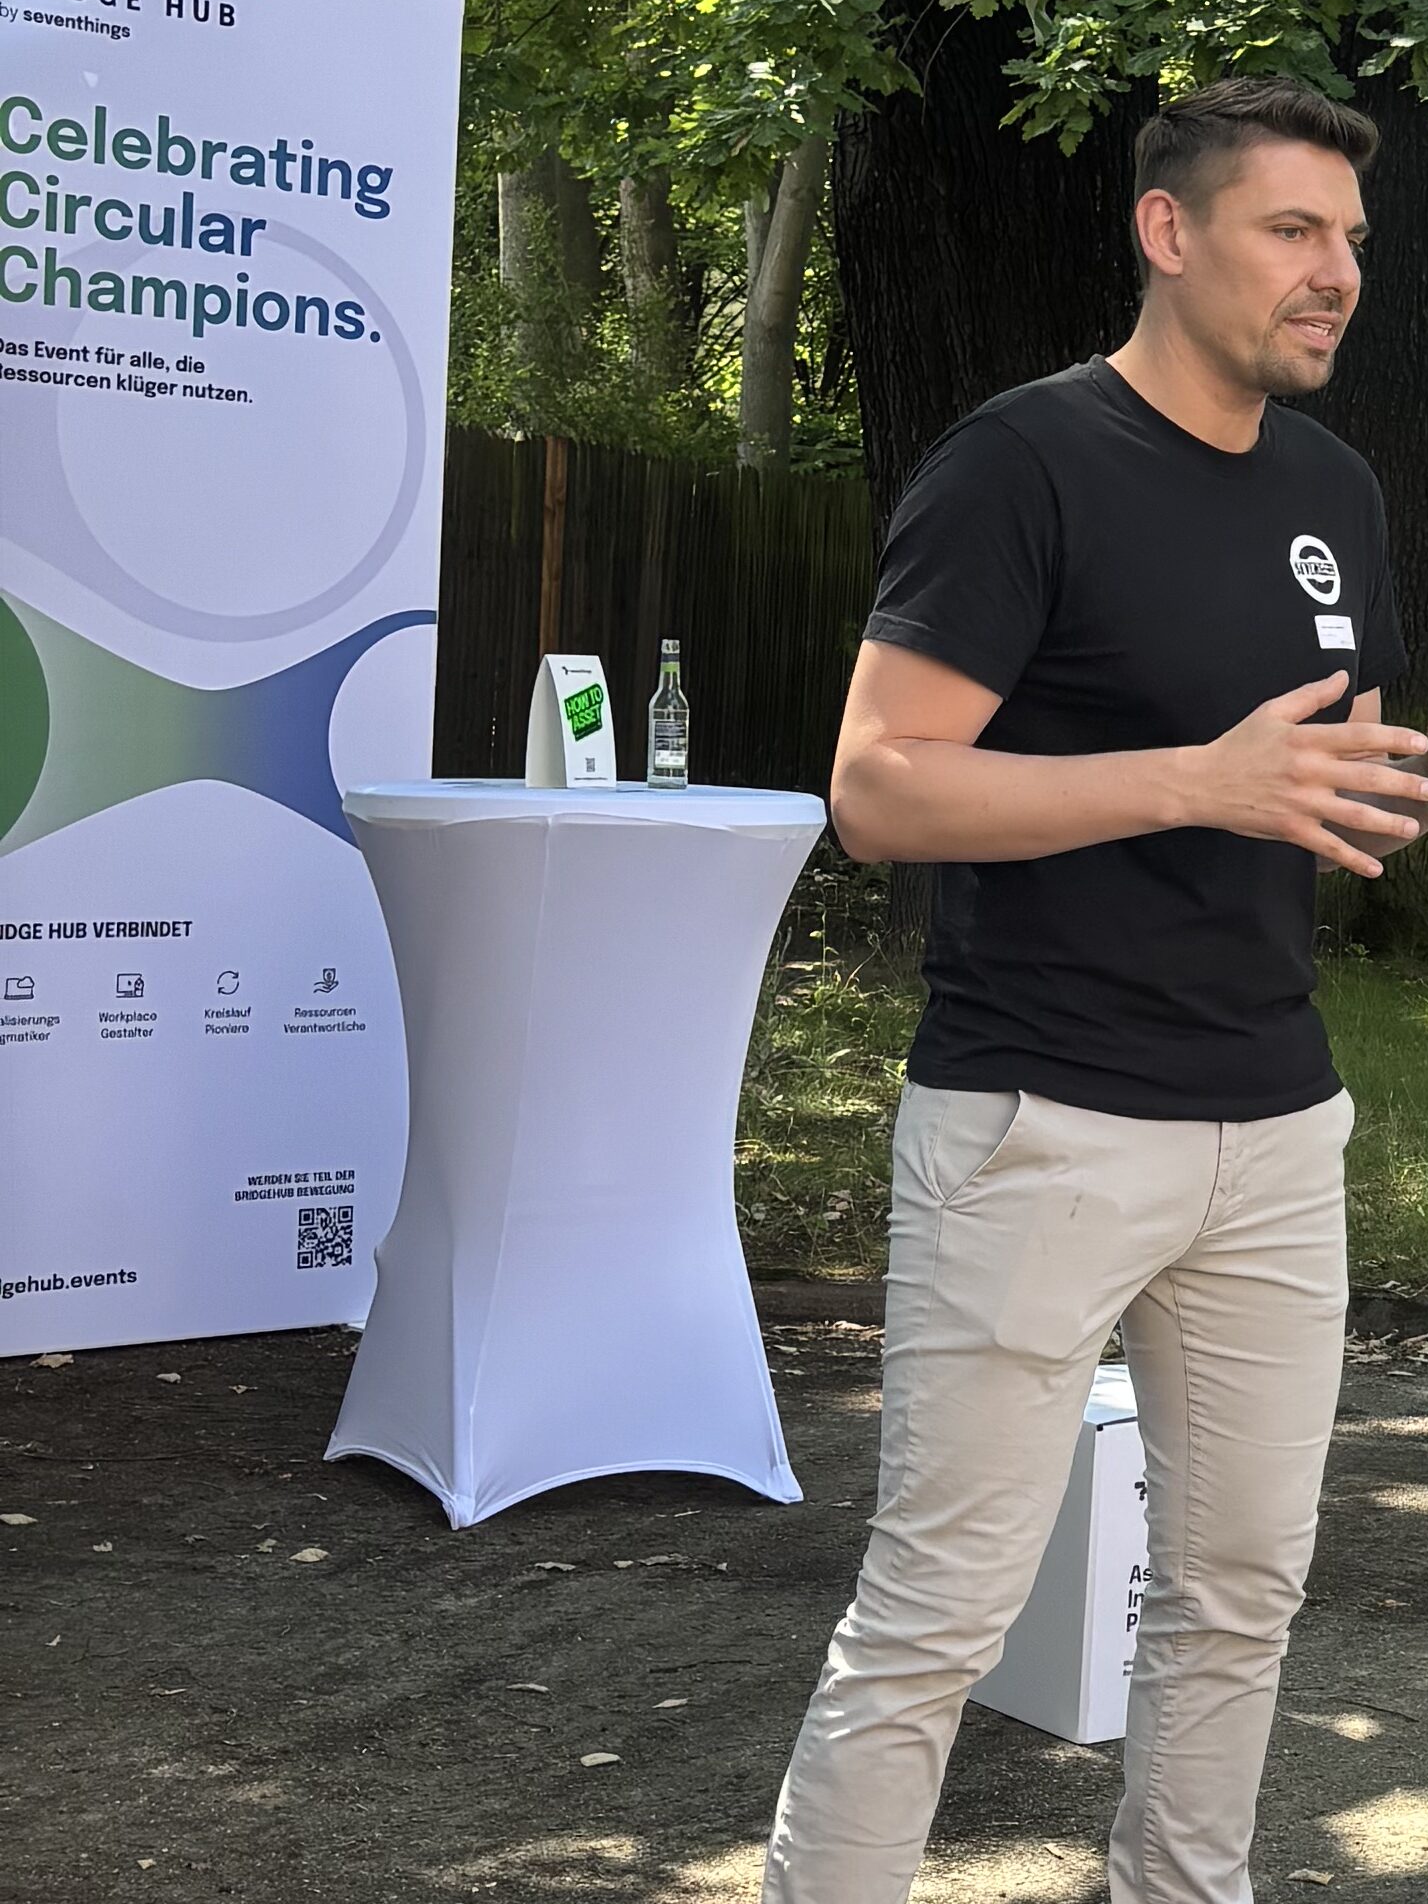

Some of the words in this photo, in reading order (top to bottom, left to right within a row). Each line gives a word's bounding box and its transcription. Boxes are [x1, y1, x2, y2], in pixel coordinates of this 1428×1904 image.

[23, 7, 131, 40] seventhings
[0, 96, 393, 219] Celebrating
[0, 170, 267, 257] Circular
[0, 244, 381, 344] Champions.
[34, 340, 90, 363] Event
[95, 346, 125, 366] für
[129, 351, 170, 373] alle,
[175, 355, 206, 374] die
[116, 373, 178, 398] klüger
[182, 384, 253, 404] nutzen.
[49, 922, 87, 939] HUB
[93, 921, 193, 938] VERBINDET
[248, 1173, 292, 1186] WERDEN
[313, 1171, 333, 1182] TEIL
[335, 1170, 355, 1181] DER
